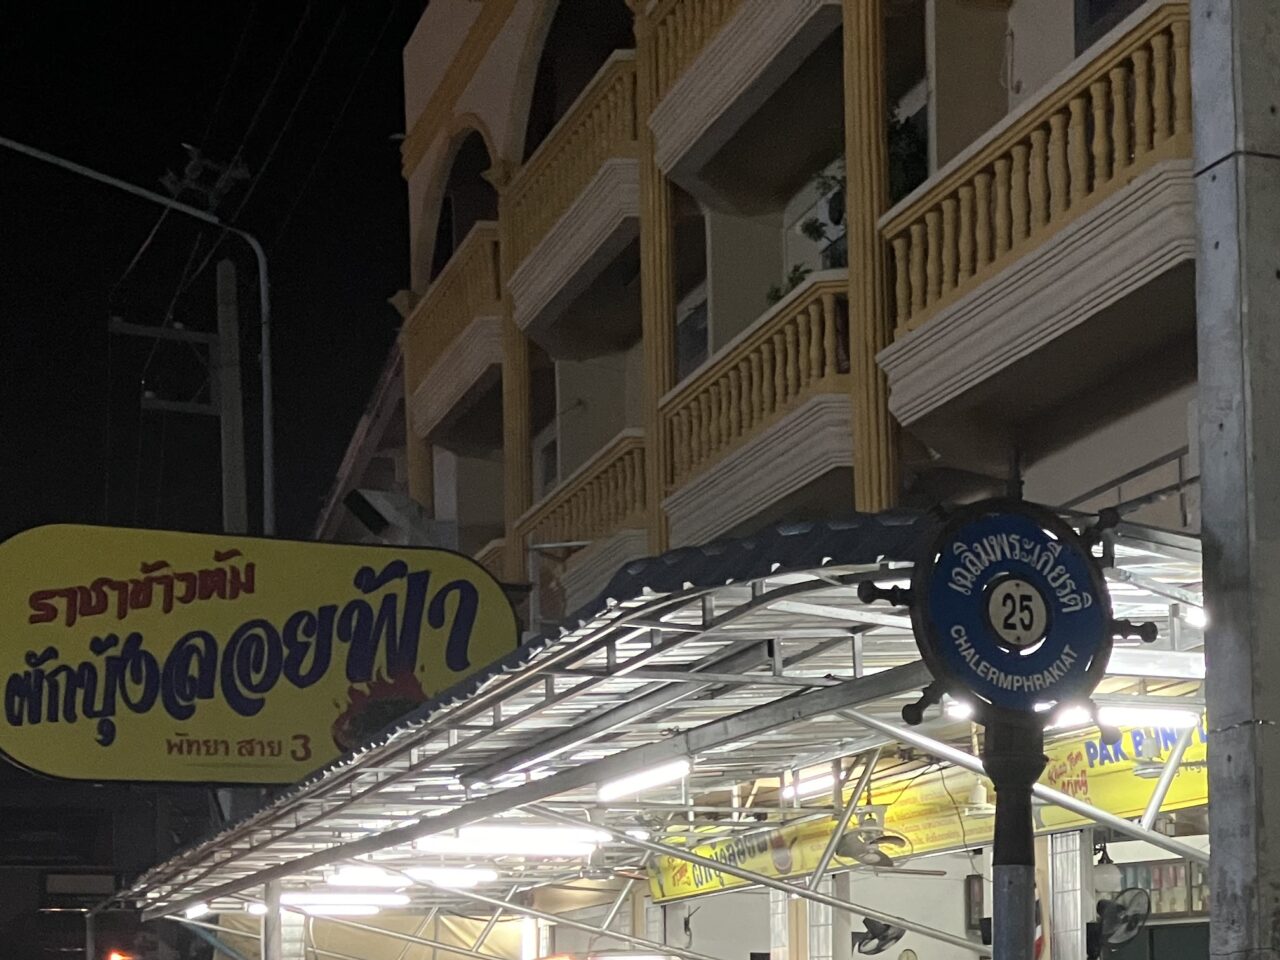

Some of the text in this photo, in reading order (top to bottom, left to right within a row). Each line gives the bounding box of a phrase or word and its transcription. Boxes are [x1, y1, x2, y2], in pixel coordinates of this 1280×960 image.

[28, 549, 256, 627] ราชาข้าวต้ม
[948, 533, 1092, 613] เฉลิมพระเกียรติ
[1001, 593, 1034, 631] 25
[5, 559, 480, 747] ผักบุ้งลอยฟ้า
[950, 624, 1079, 693] CHALERMPHRAKIAT
[165, 732, 312, 762] พัทยา สาย 3
